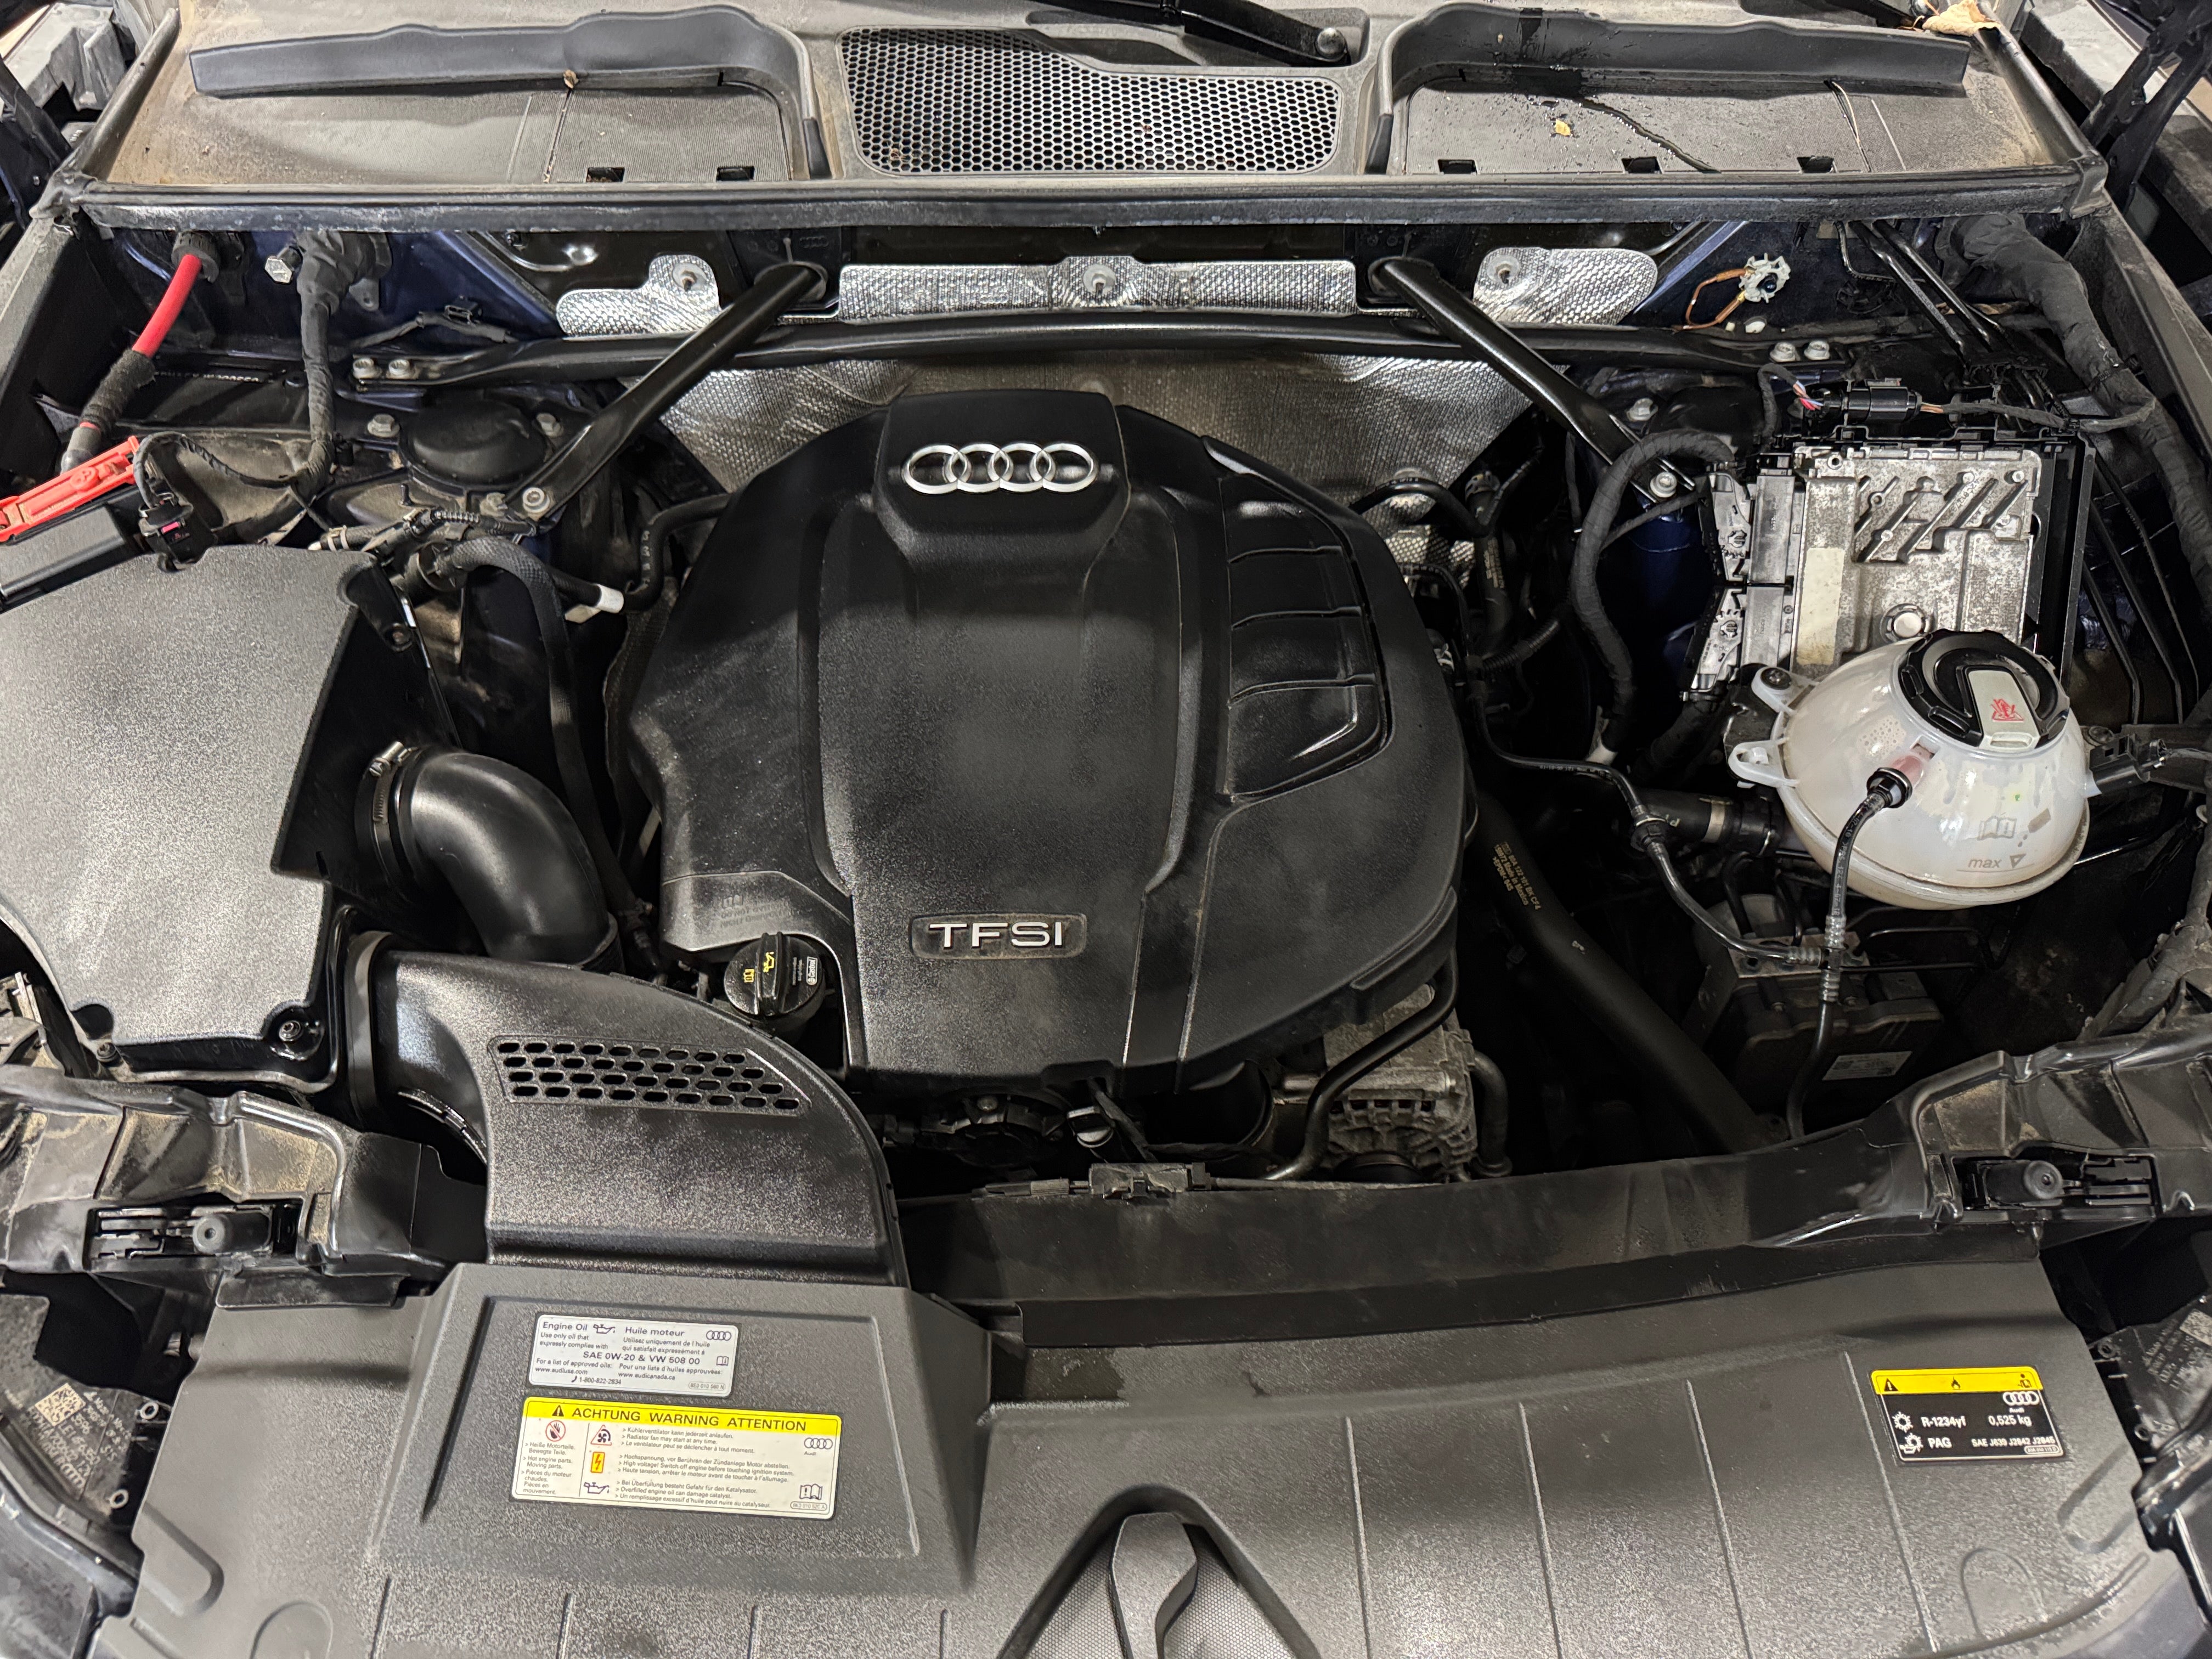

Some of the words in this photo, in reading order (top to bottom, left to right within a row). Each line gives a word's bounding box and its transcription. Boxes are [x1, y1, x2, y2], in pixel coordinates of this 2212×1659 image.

[1967, 857, 2002, 868] max
[928, 921, 1063, 949] TFSI
[542, 1322, 573, 1331] Engine
[568, 1341, 594, 1350] complies
[646, 1338, 681, 1346] uniquement
[605, 1352, 635, 1361] 0W-20
[571, 1407, 641, 1421] ACHTUNG
[648, 1412, 719, 1426] WARNING
[726, 1417, 806, 1431] ATTENTION
[1920, 1415, 1968, 1429] R-1234yf
[1987, 1414, 2018, 1426] 0,525
[2016, 1414, 2033, 1426] kg
[1927, 1437, 1953, 1448] PAG
[1971, 1438, 1988, 1447] SAE
[629, 1493, 662, 1502] remplissage
